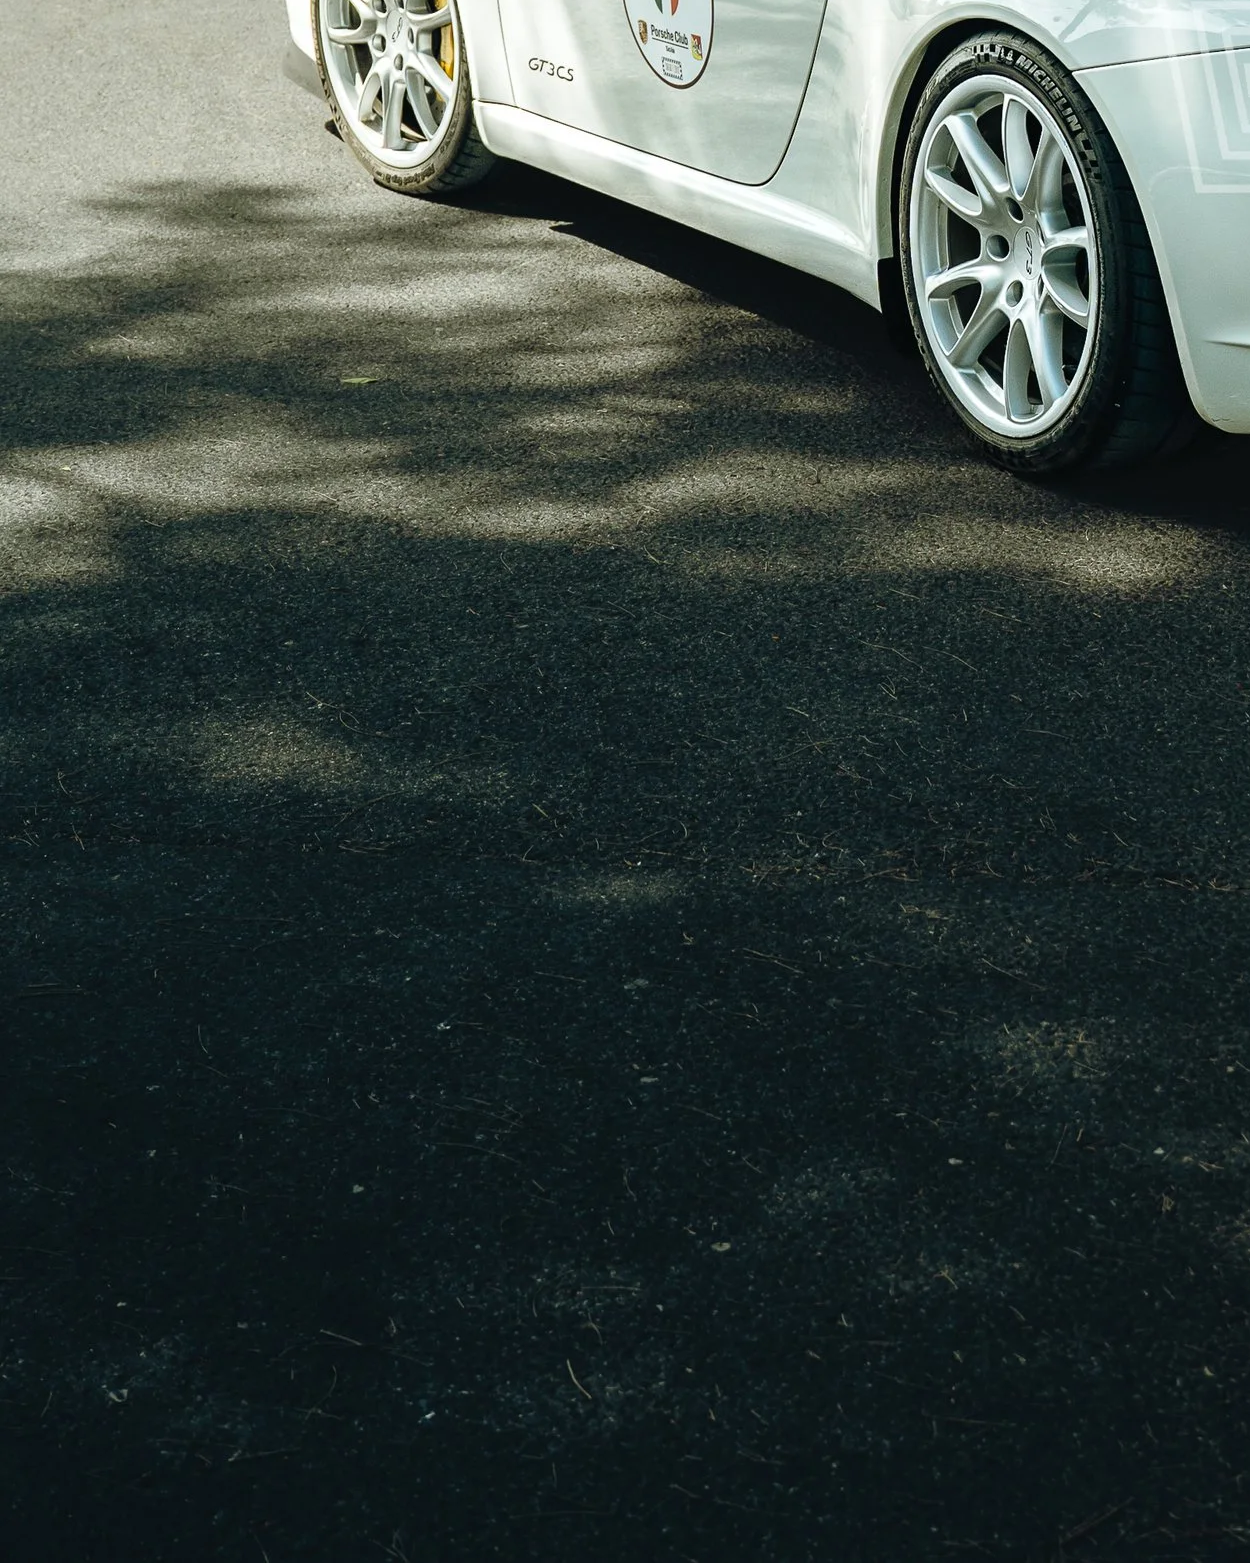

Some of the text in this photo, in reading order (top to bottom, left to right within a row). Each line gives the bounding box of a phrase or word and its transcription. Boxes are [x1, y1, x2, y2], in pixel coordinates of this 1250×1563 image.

[650, 24, 689, 46] Porsche Club
[1013, 54, 1082, 132] MICHELIN
